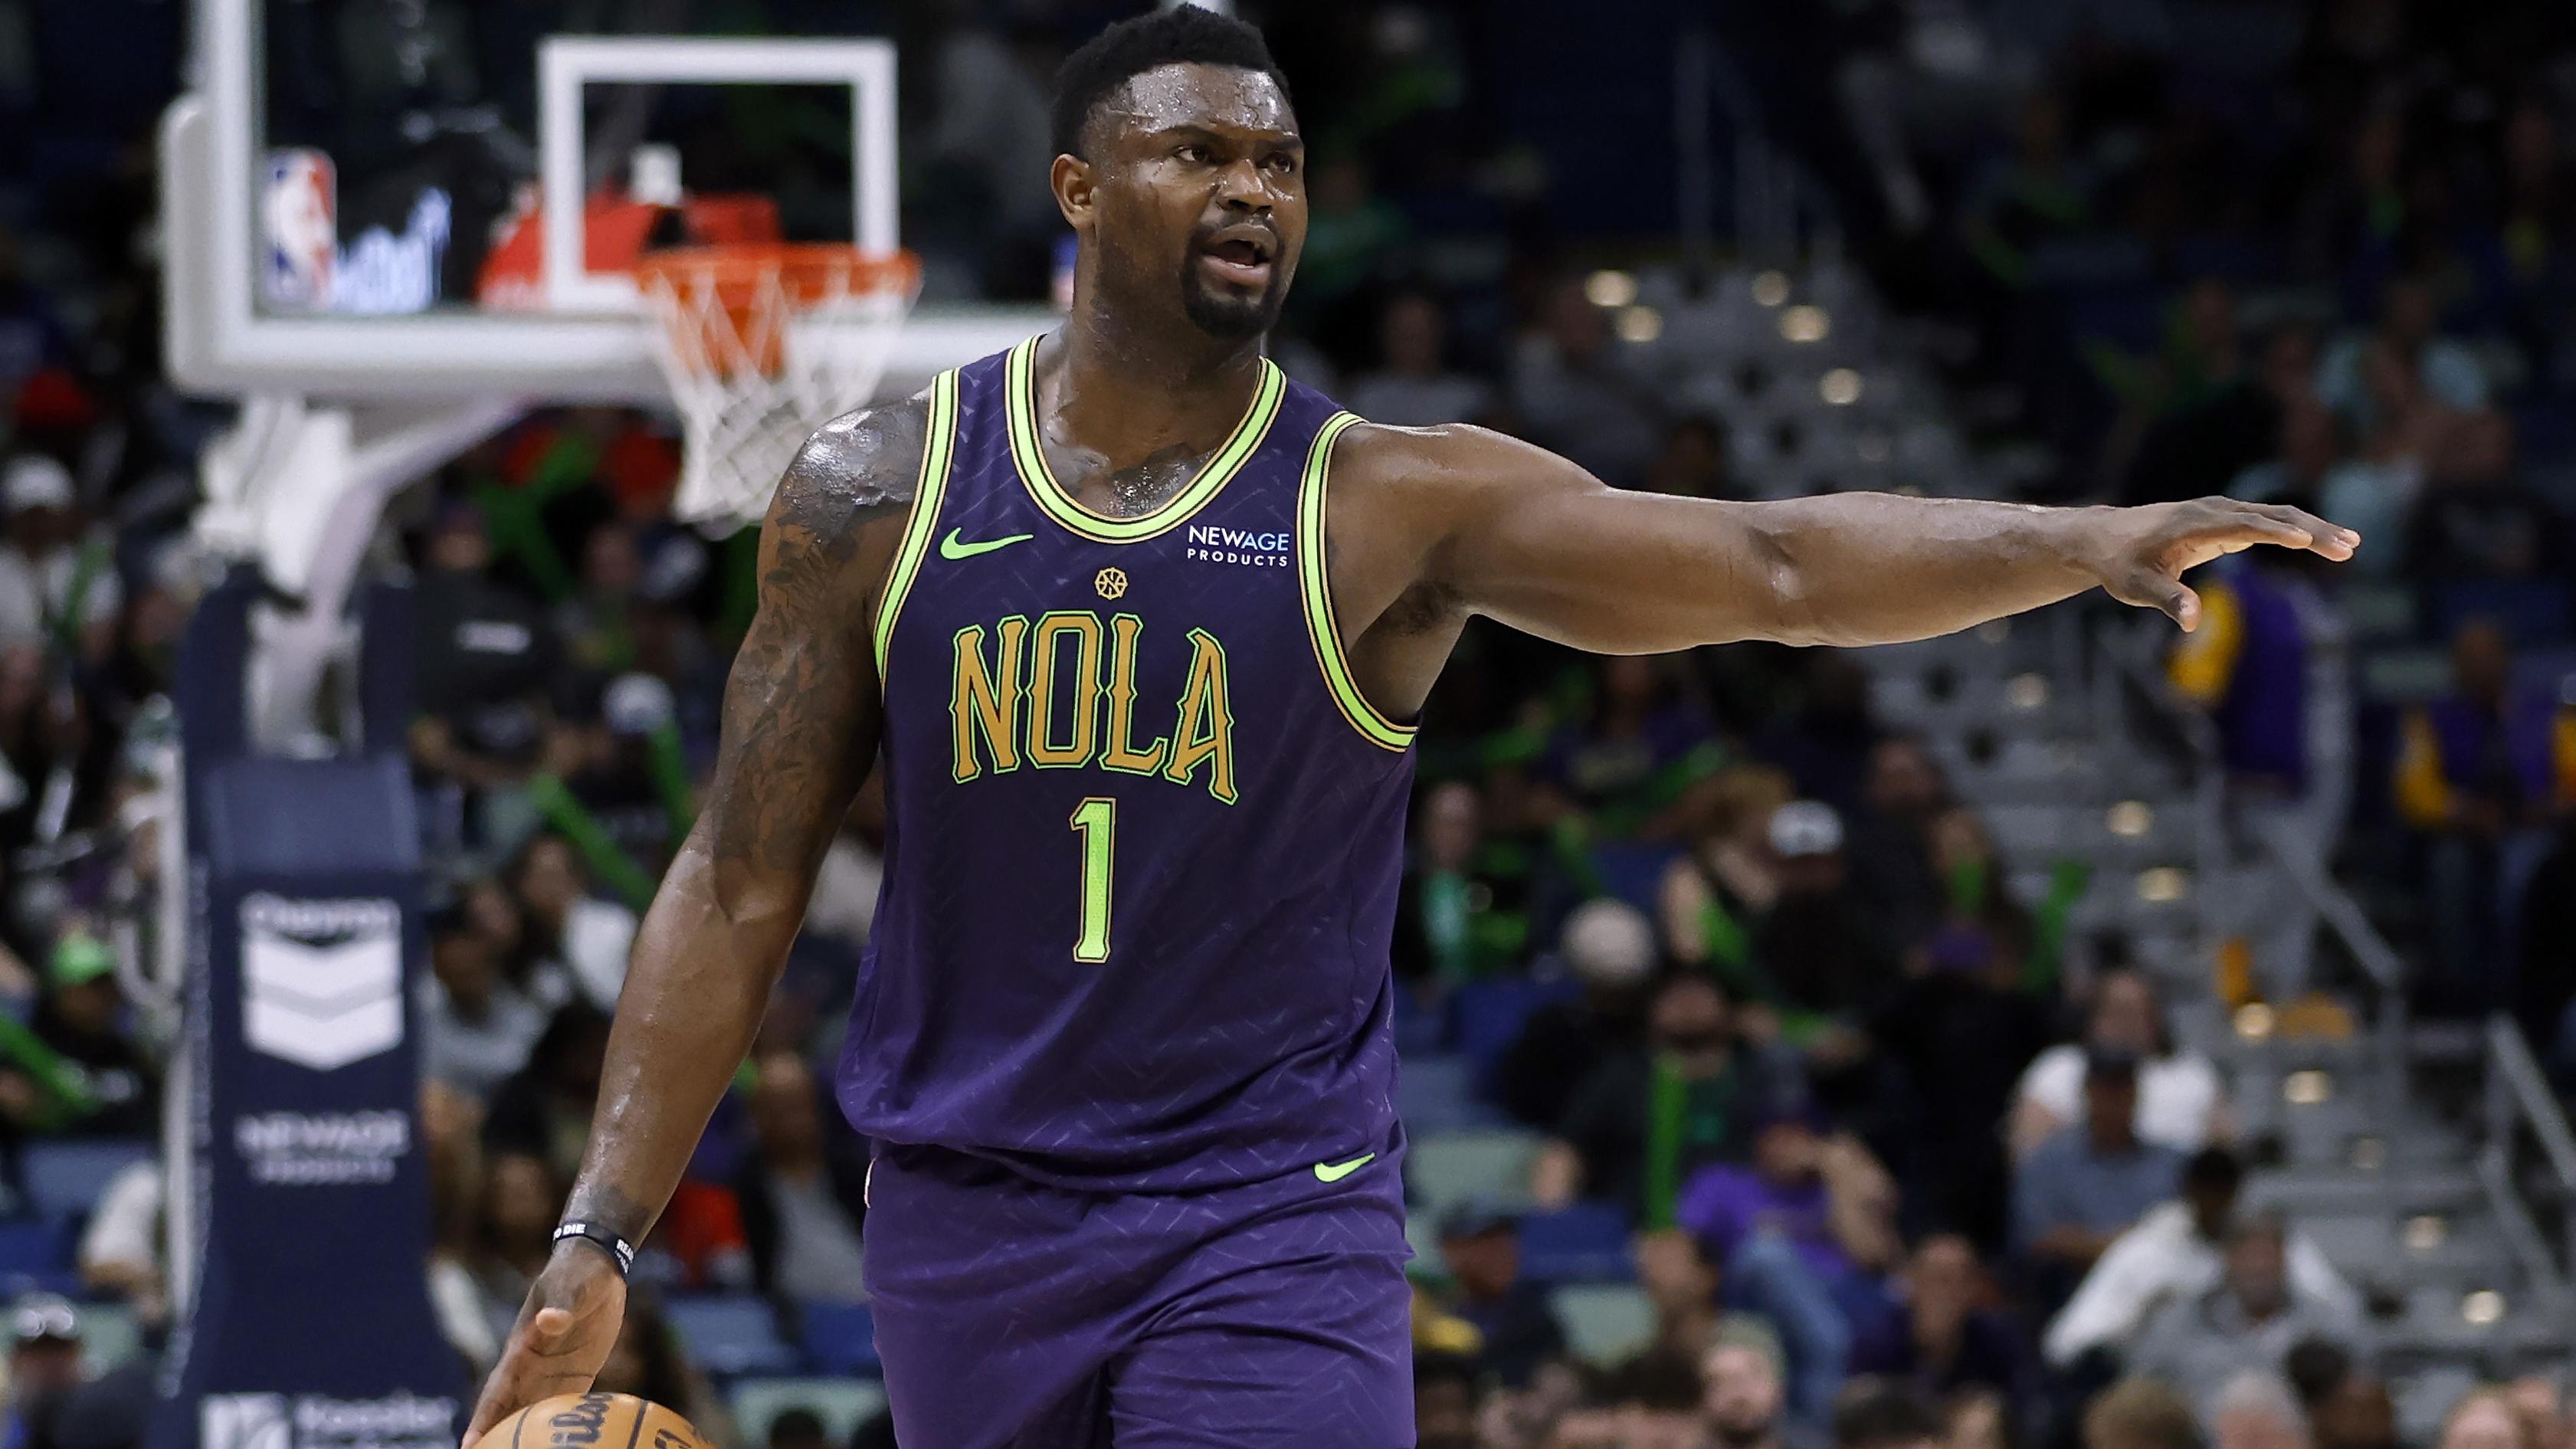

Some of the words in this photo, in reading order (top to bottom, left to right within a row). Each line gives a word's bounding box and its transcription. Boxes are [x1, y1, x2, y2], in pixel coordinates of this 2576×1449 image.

[1188, 525, 1290, 551] NEWAGE
[1187, 548, 1288, 567] PRODUCTS
[949, 610, 1239, 805] NOLA
[1070, 797, 1116, 963] 1
[553, 1228, 562, 1241] O
[563, 1224, 586, 1236] DIE
